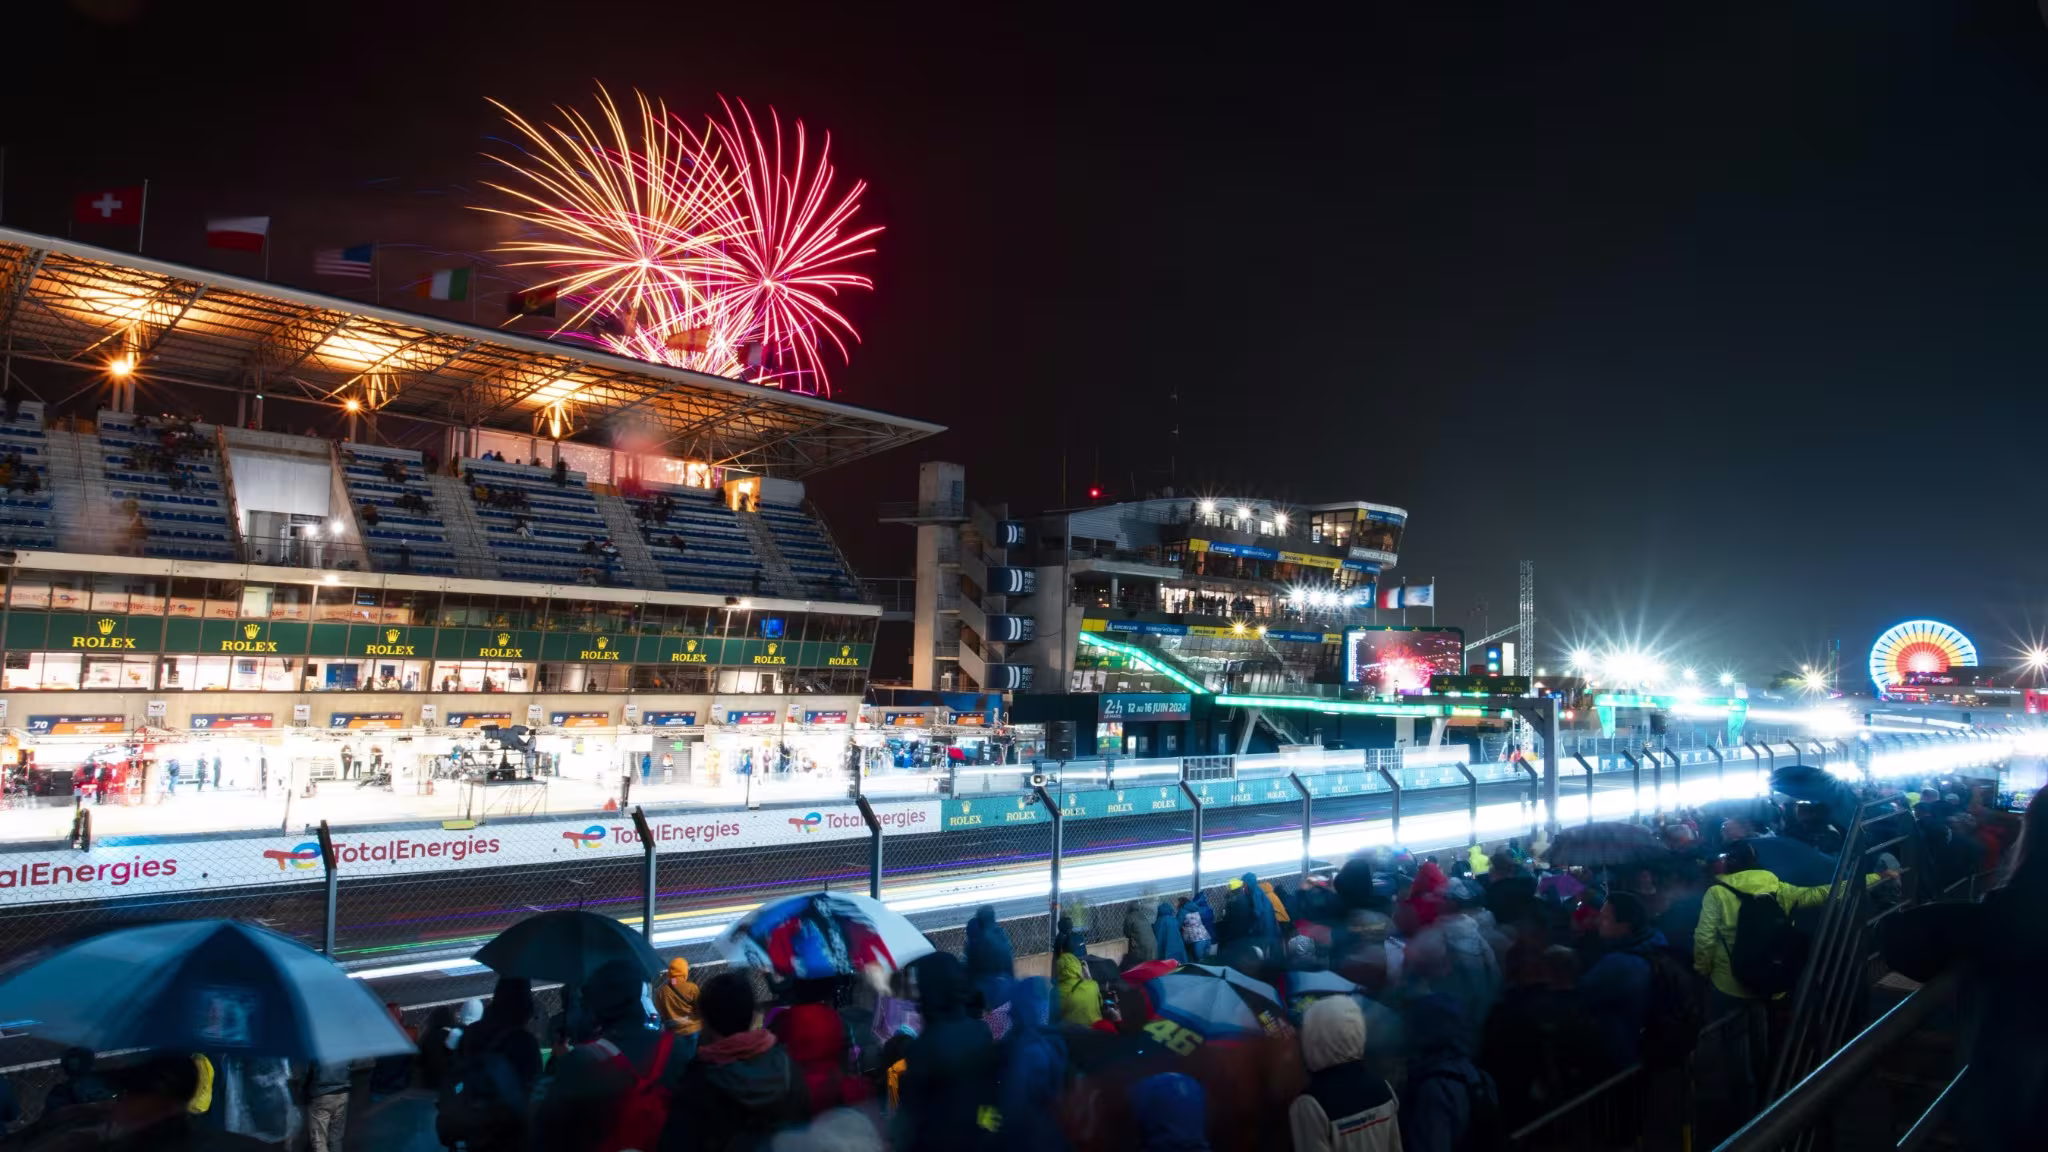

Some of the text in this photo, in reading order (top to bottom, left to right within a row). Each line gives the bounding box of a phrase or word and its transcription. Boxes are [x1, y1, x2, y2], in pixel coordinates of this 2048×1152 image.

[72, 636, 137, 649] ROLEX
[221, 641, 278, 652] ROLEX
[366, 645, 415, 656] ROLEX
[479, 648, 523, 658] ROLEX
[580, 651, 620, 660] ROLEX
[671, 653, 707, 663] ROLEX
[753, 656, 786, 664] ROLEX
[828, 658, 859, 666] ROLEX
[1128, 703, 1135, 712] 12
[1145, 703, 1152, 712] 16
[1153, 703, 1168, 714] JUIN
[1169, 703, 1186, 712] 2024
[33, 721, 48, 729] 70
[194, 718, 208, 727] 99
[334, 717, 346, 725] 77
[449, 716, 461, 724] 44
[1107, 804, 1133, 813] ROLEX
[1152, 800, 1176, 809] ROLEX
[826, 809, 925, 828] Totalnergies
[949, 815, 982, 826] ROLEX
[1006, 811, 1036, 822] ROLEX
[331, 835, 500, 863] TotalEnergies
